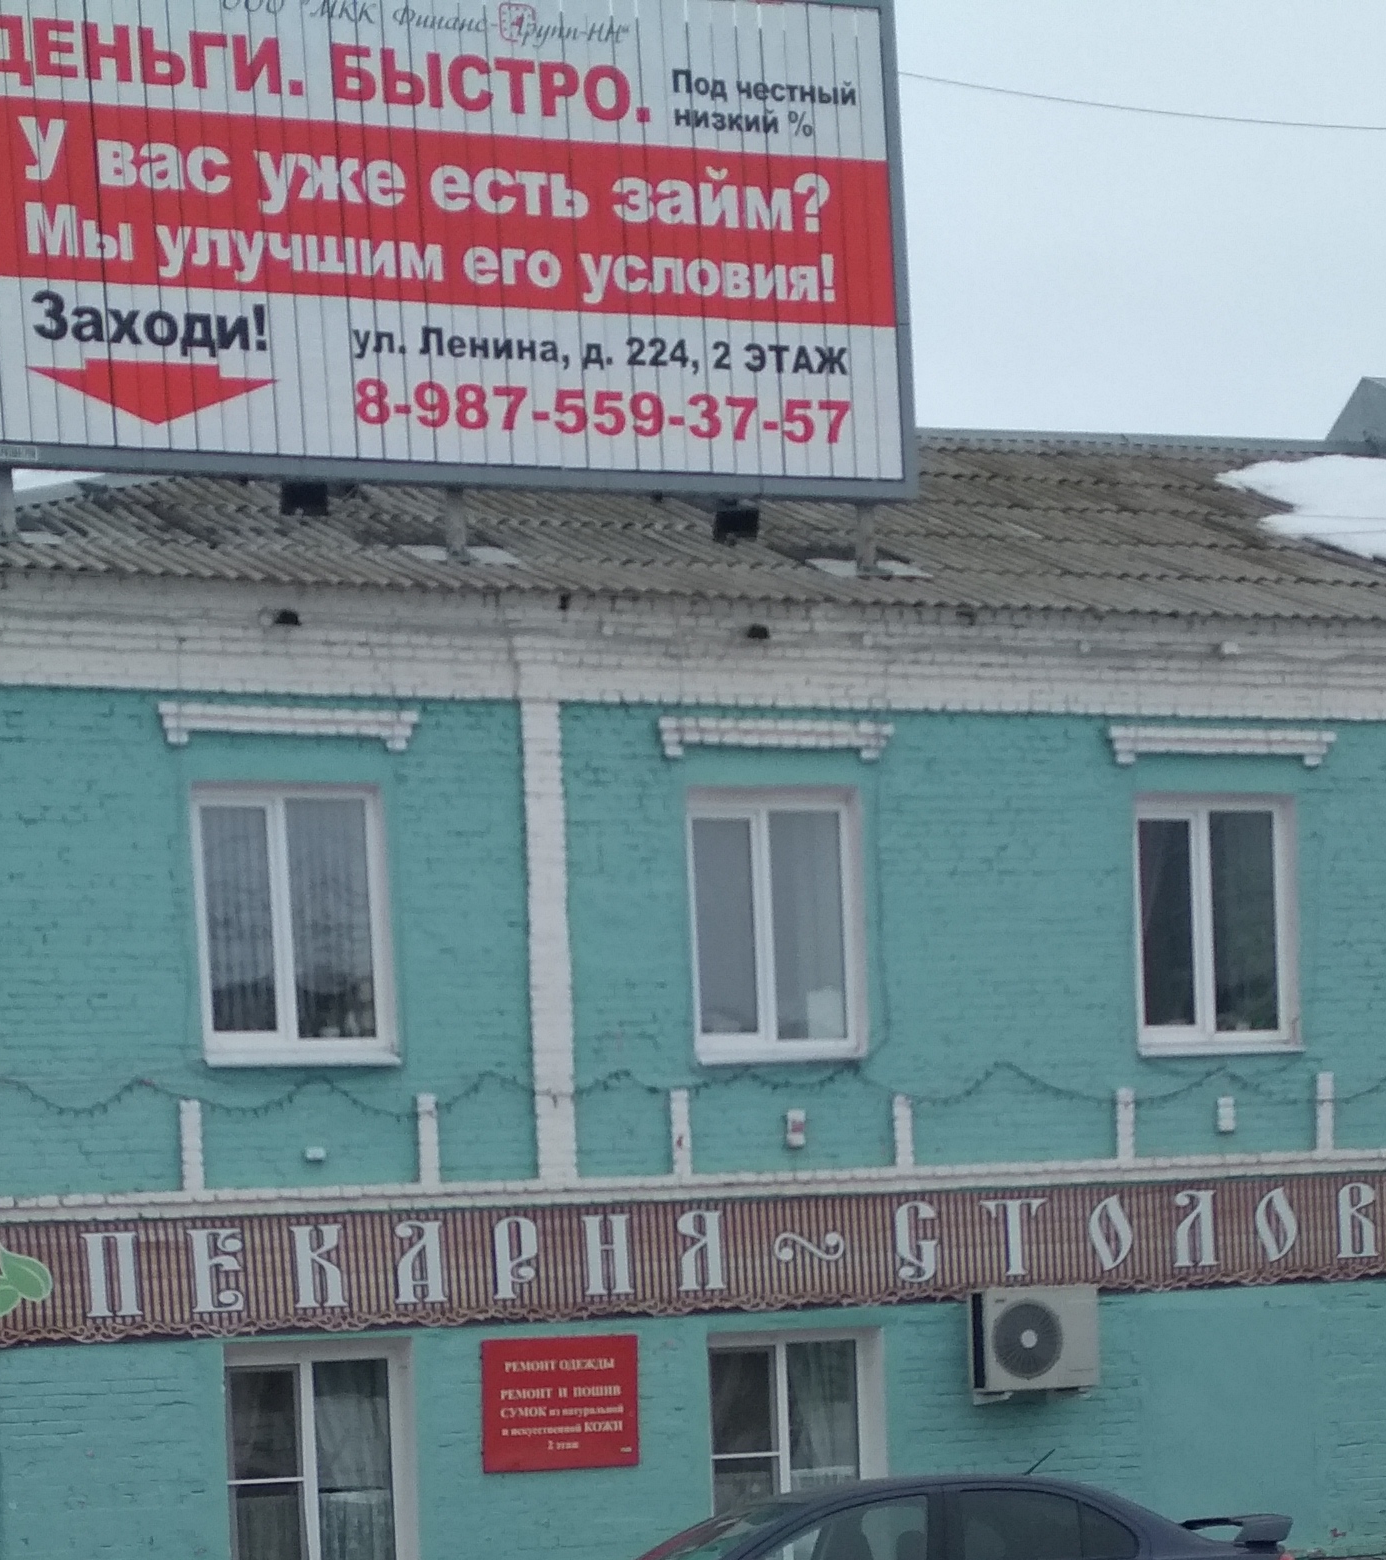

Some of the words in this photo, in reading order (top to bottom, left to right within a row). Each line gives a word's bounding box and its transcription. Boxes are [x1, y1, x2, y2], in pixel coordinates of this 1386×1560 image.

[331, 43, 651, 123] БЫСТРО.
[671, 68, 729, 102] Под
[736, 78, 858, 106] честный
[674, 105, 780, 135] низкий
[788, 110, 815, 138] %
[18, 115, 67, 181] У
[97, 138, 232, 194] вас
[254, 149, 406, 215] уже
[430, 163, 589, 219] есть
[612, 165, 831, 233] займ?
[24, 201, 134, 262] Мы
[156, 224, 445, 283] улучшим
[463, 243, 562, 288] его
[579, 251, 837, 304] условия!
[31, 289, 269, 358] Заходи!
[353, 327, 406, 358] ул.
[419, 326, 571, 371] Ленина,
[582, 342, 614, 371] д.
[626, 337, 700, 375] 224,
[713, 341, 732, 370] 2
[743, 343, 849, 376] ЭТАЖ
[355, 377, 852, 445] 8-987-559-37-57
[80, 1210, 728, 1317] ПЕКАРНЯ
[504, 1359, 556, 1373] РЕМОНТ
[558, 1357, 615, 1372] ОДЕЖДЫ
[500, 1387, 553, 1401] РЕМОНТ
[558, 1386, 568, 1398] И
[573, 1384, 622, 1397] ПОШИВ
[500, 1406, 548, 1419] СУМОК
[584, 1420, 623, 1433] КОЖИ
